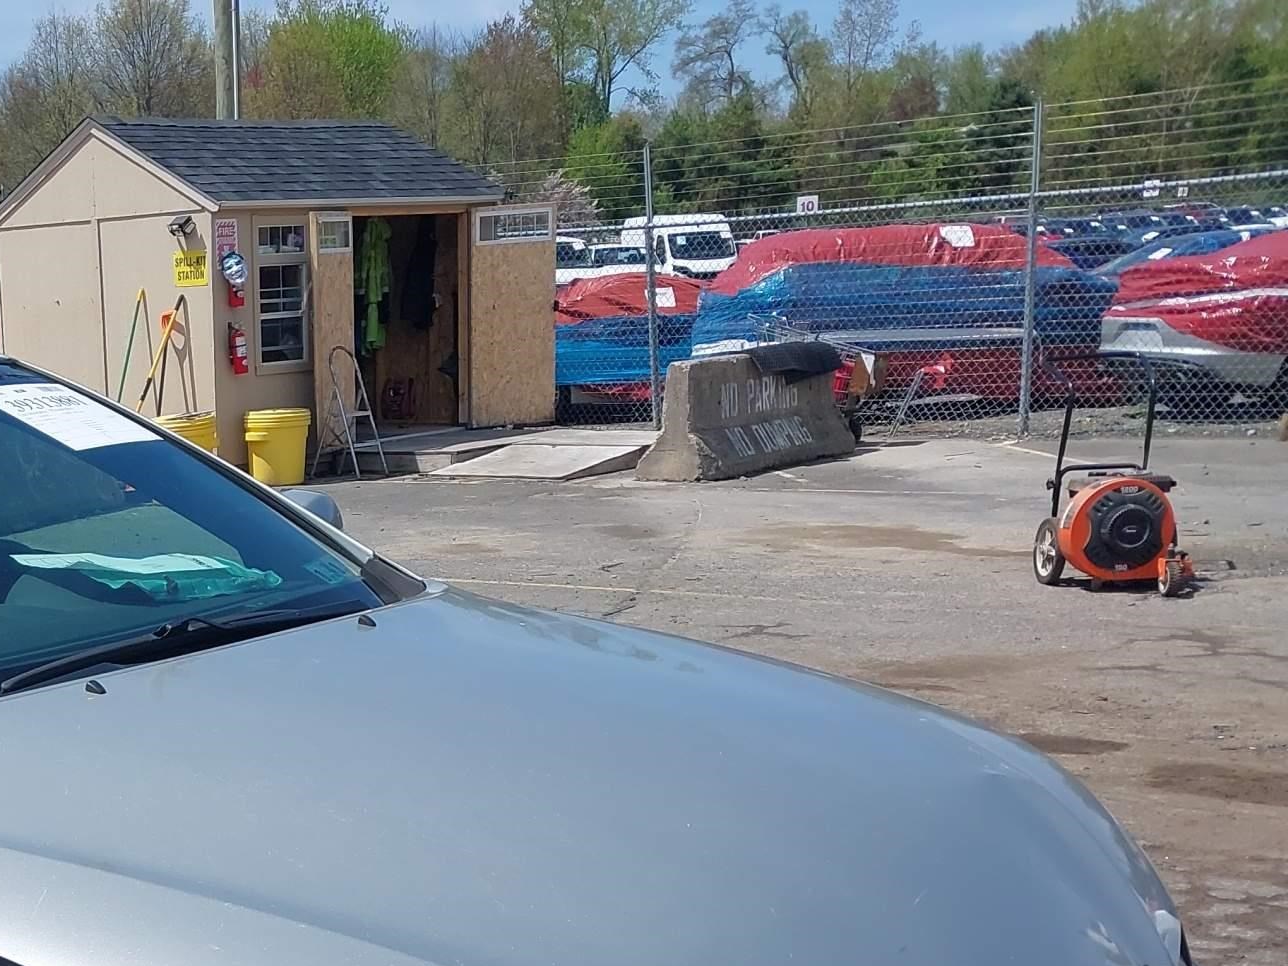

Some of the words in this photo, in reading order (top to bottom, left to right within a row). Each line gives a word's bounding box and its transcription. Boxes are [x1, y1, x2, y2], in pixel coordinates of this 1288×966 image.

[801, 201, 815, 212] 10
[218, 227, 234, 236] FIRE
[175, 255, 206, 268] SPILL-KIT
[177, 269, 205, 282] STATION
[720, 383, 738, 419] NO
[746, 375, 798, 414] PARKING
[724, 426, 756, 457] NO
[752, 415, 812, 453] DUMPING
